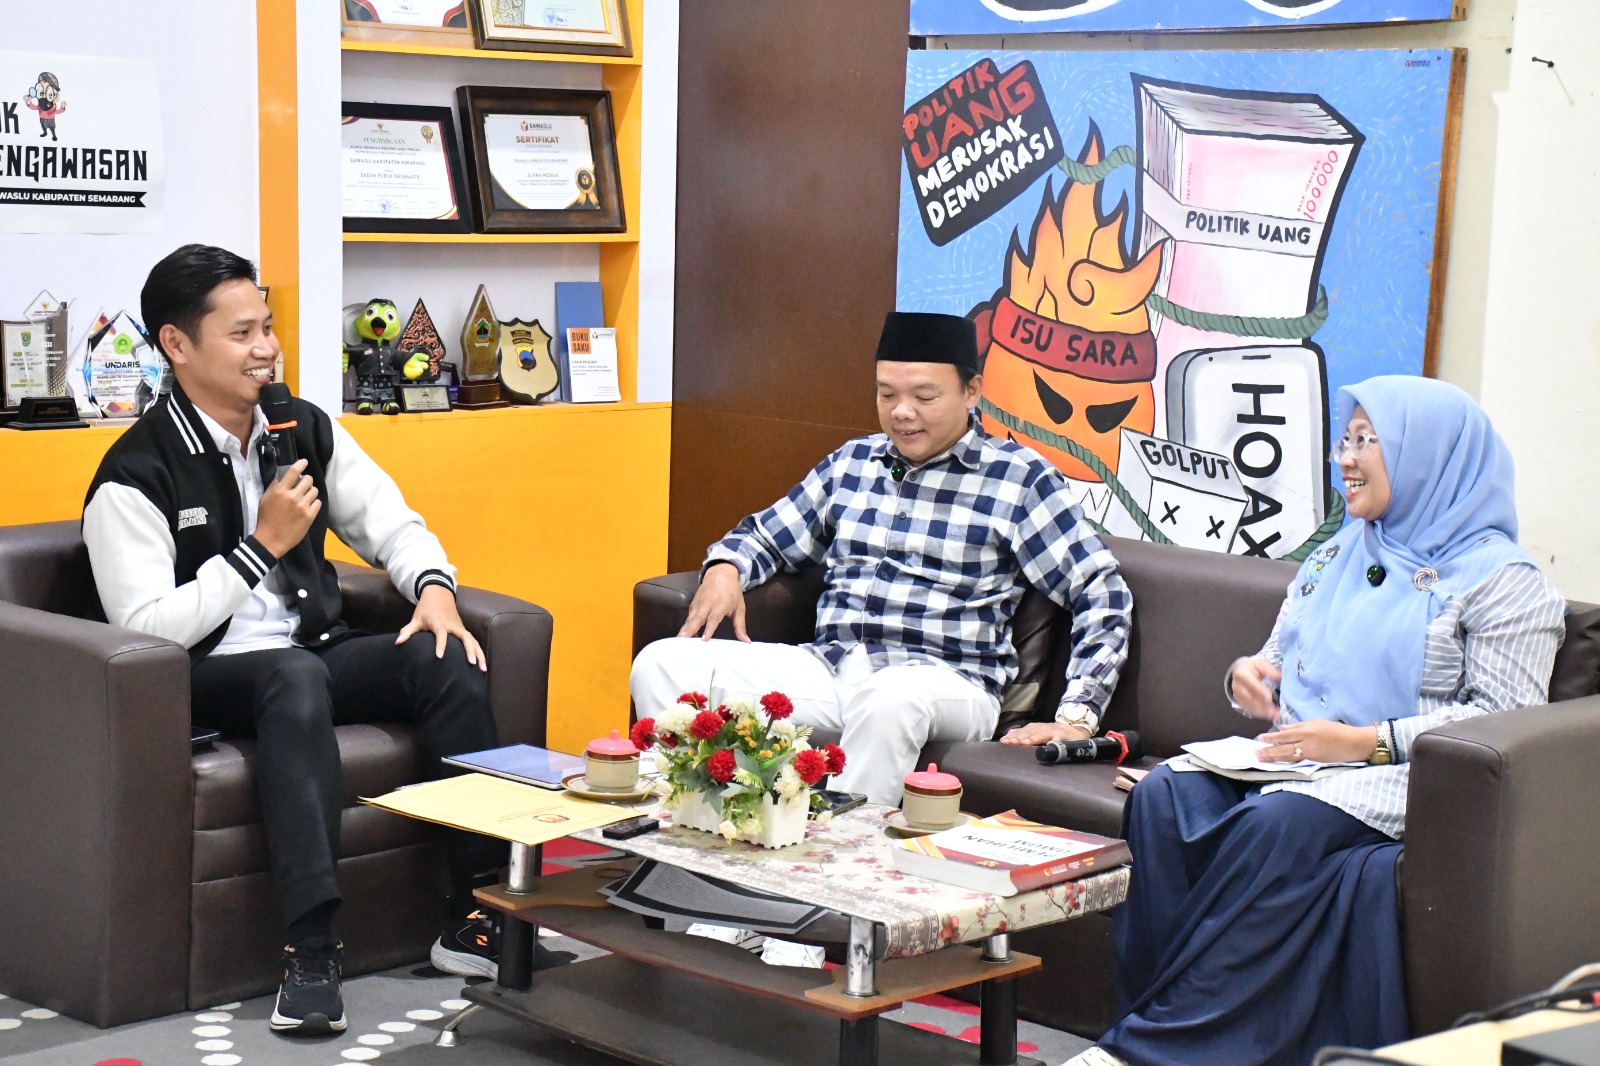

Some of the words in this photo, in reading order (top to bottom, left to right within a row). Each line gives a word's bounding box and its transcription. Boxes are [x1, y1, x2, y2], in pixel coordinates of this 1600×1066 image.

[903, 61, 995, 141] POLITIK
[911, 64, 1036, 169] UANG
[917, 115, 1028, 197] MERUSAK
[926, 126, 1054, 228] DEMOKRASI
[1303, 150, 1338, 220] 100000
[32, 192, 86, 202] KABUPATEN
[87, 194, 136, 203] SEMARANG
[1186, 210, 1250, 236] POLITIK
[1258, 222, 1311, 245] UANG
[571, 333, 589, 342] BUKU
[572, 343, 590, 352] SAKU
[1010, 315, 1055, 352] ISU
[1065, 333, 1139, 367] SARA
[1139, 439, 1230, 480] GOLPUT
[1231, 383, 1286, 559] HOAX
